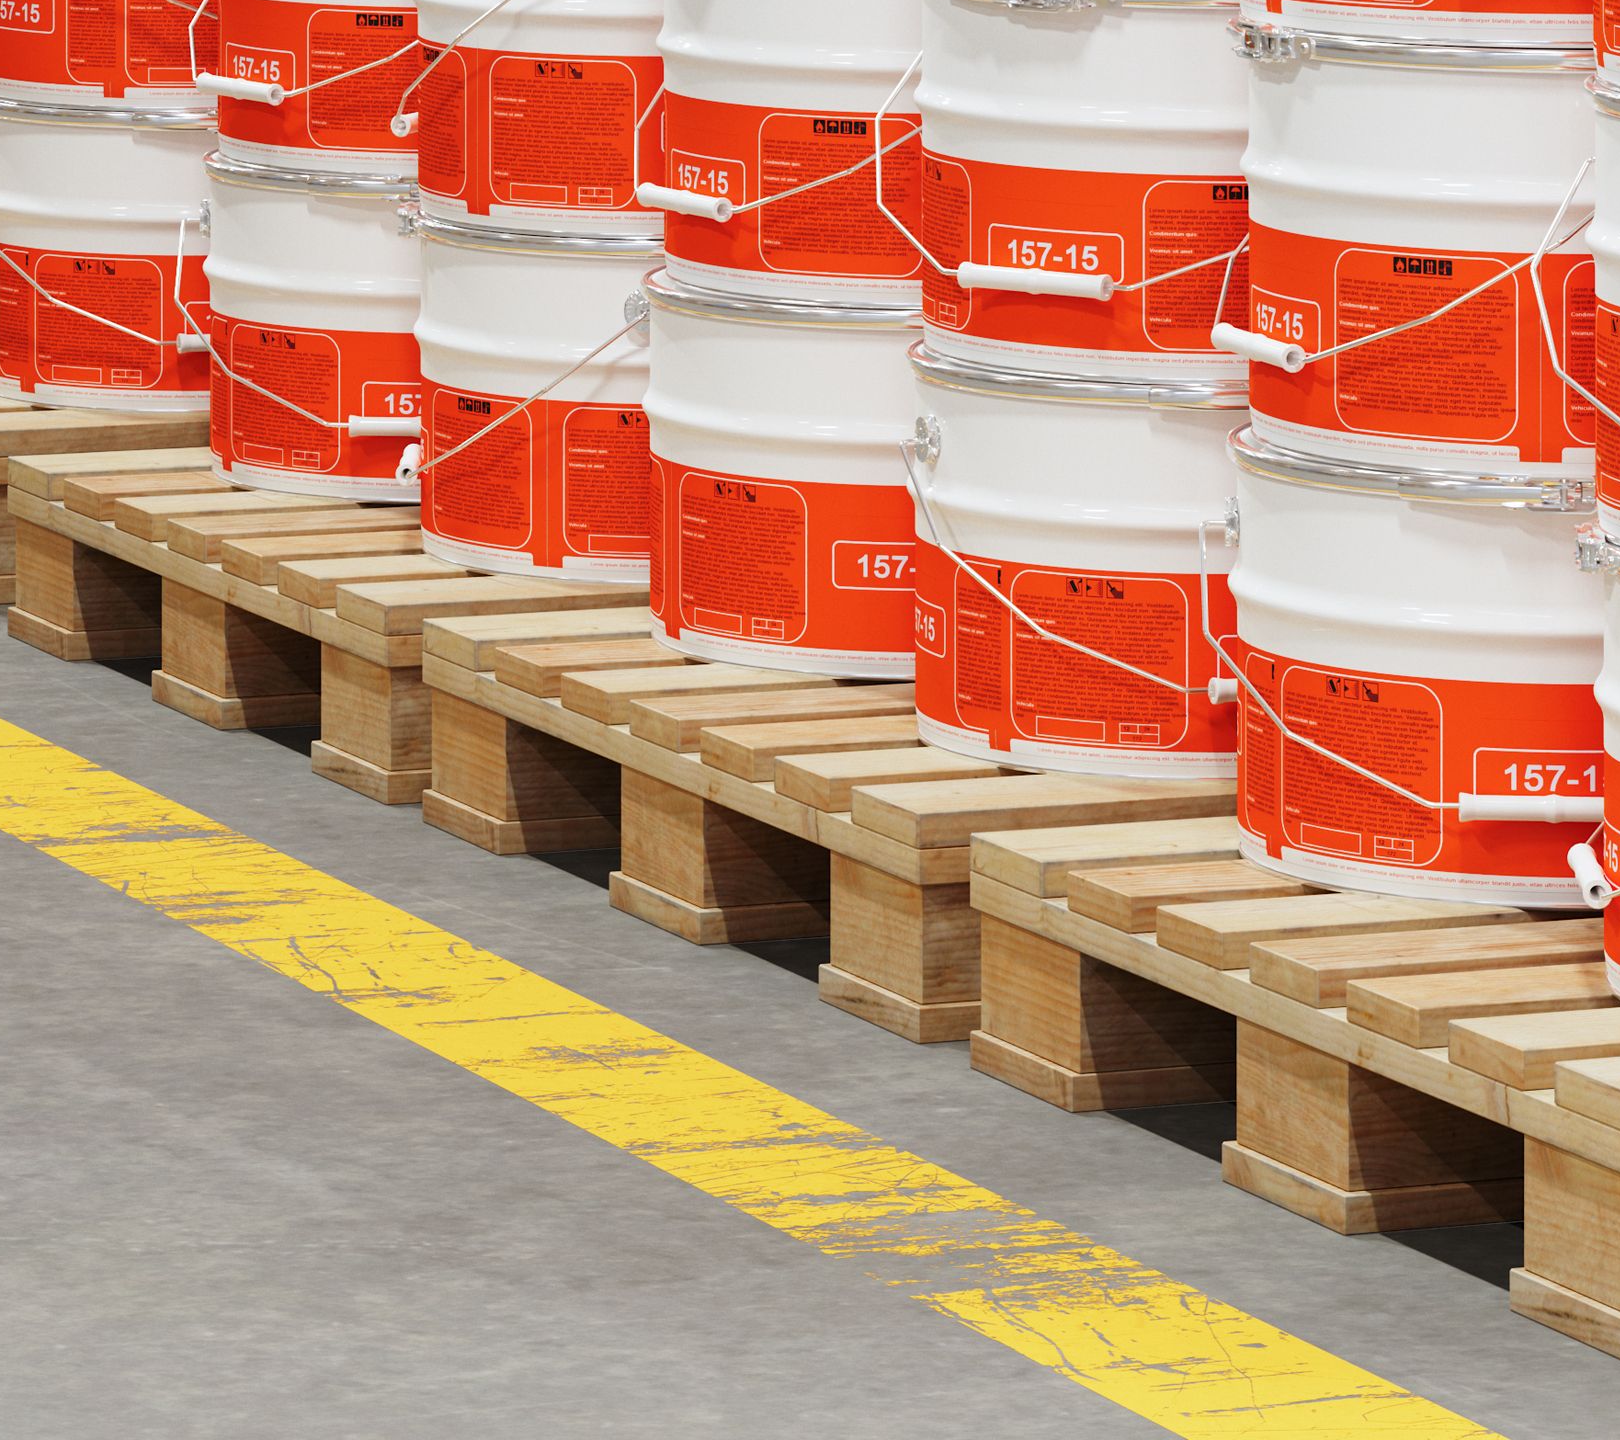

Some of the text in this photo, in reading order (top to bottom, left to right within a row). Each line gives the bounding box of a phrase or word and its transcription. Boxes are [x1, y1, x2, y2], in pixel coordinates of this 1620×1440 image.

[233, 55, 280, 81] 157-15
[679, 164, 728, 194] 157-15
[1008, 239, 1098, 271] 157-15
[1257, 303, 1303, 340] 157-15
[858, 555, 916, 579] 157-
[1504, 765, 1597, 792] 157-1
